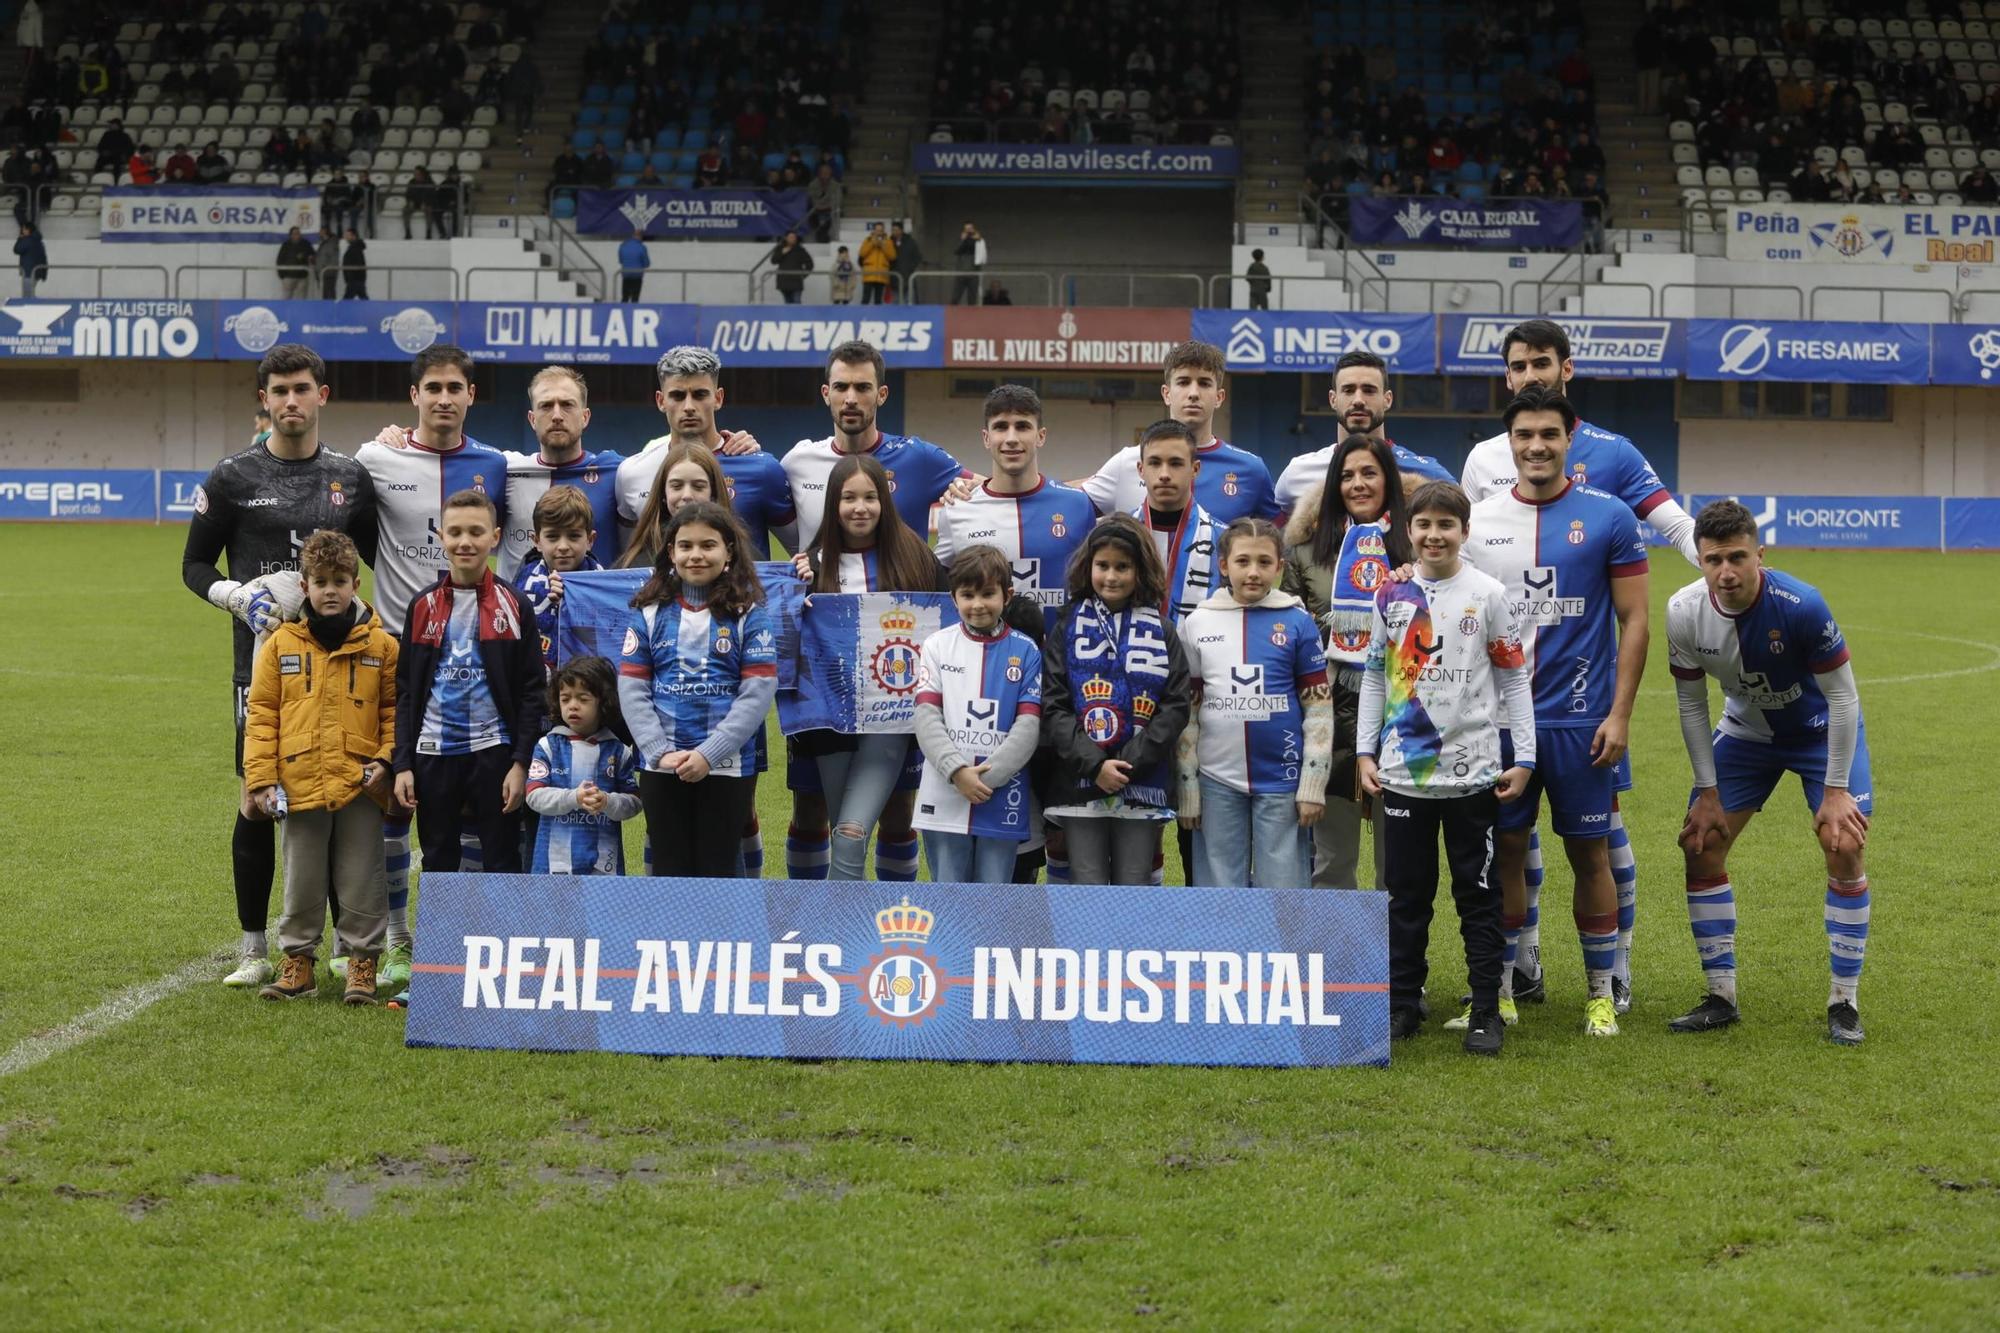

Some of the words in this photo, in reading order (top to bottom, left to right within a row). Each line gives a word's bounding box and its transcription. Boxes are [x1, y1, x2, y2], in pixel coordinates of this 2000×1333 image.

[933, 149, 1213, 172] www.realavilescf.com
[132, 203, 198, 224] PEÑA
[208, 202, 288, 224] ÓRSAY
[666, 201, 706, 215] CAJA
[710, 201, 767, 215] RURAL
[1440, 209, 1479, 225] CAJA
[1484, 210, 1540, 226] RURAL
[1737, 211, 1799, 234] Peña
[1904, 213, 1940, 236] EL
[1766, 247, 1802, 259] con
[1926, 238, 1993, 262] Real
[79, 301, 194, 317] METALISTERÍA
[530, 308, 660, 347] MILAR
[757, 321, 932, 351] NEVARES
[952, 339, 998, 361] REAL
[1004, 340, 1067, 362] AVILES
[1274, 327, 1401, 354] INEXO
[1777, 340, 1900, 361] FRESAMEX
[248, 498, 279, 507] NOONE
[1787, 509, 1900, 528] HORIZONTE
[1207, 696, 1289, 711] HORIZONTE
[462, 934, 614, 1012] REAL
[630, 931, 842, 1017] AVILÉS
[972, 946, 1342, 1027] INDUSTRIAL
